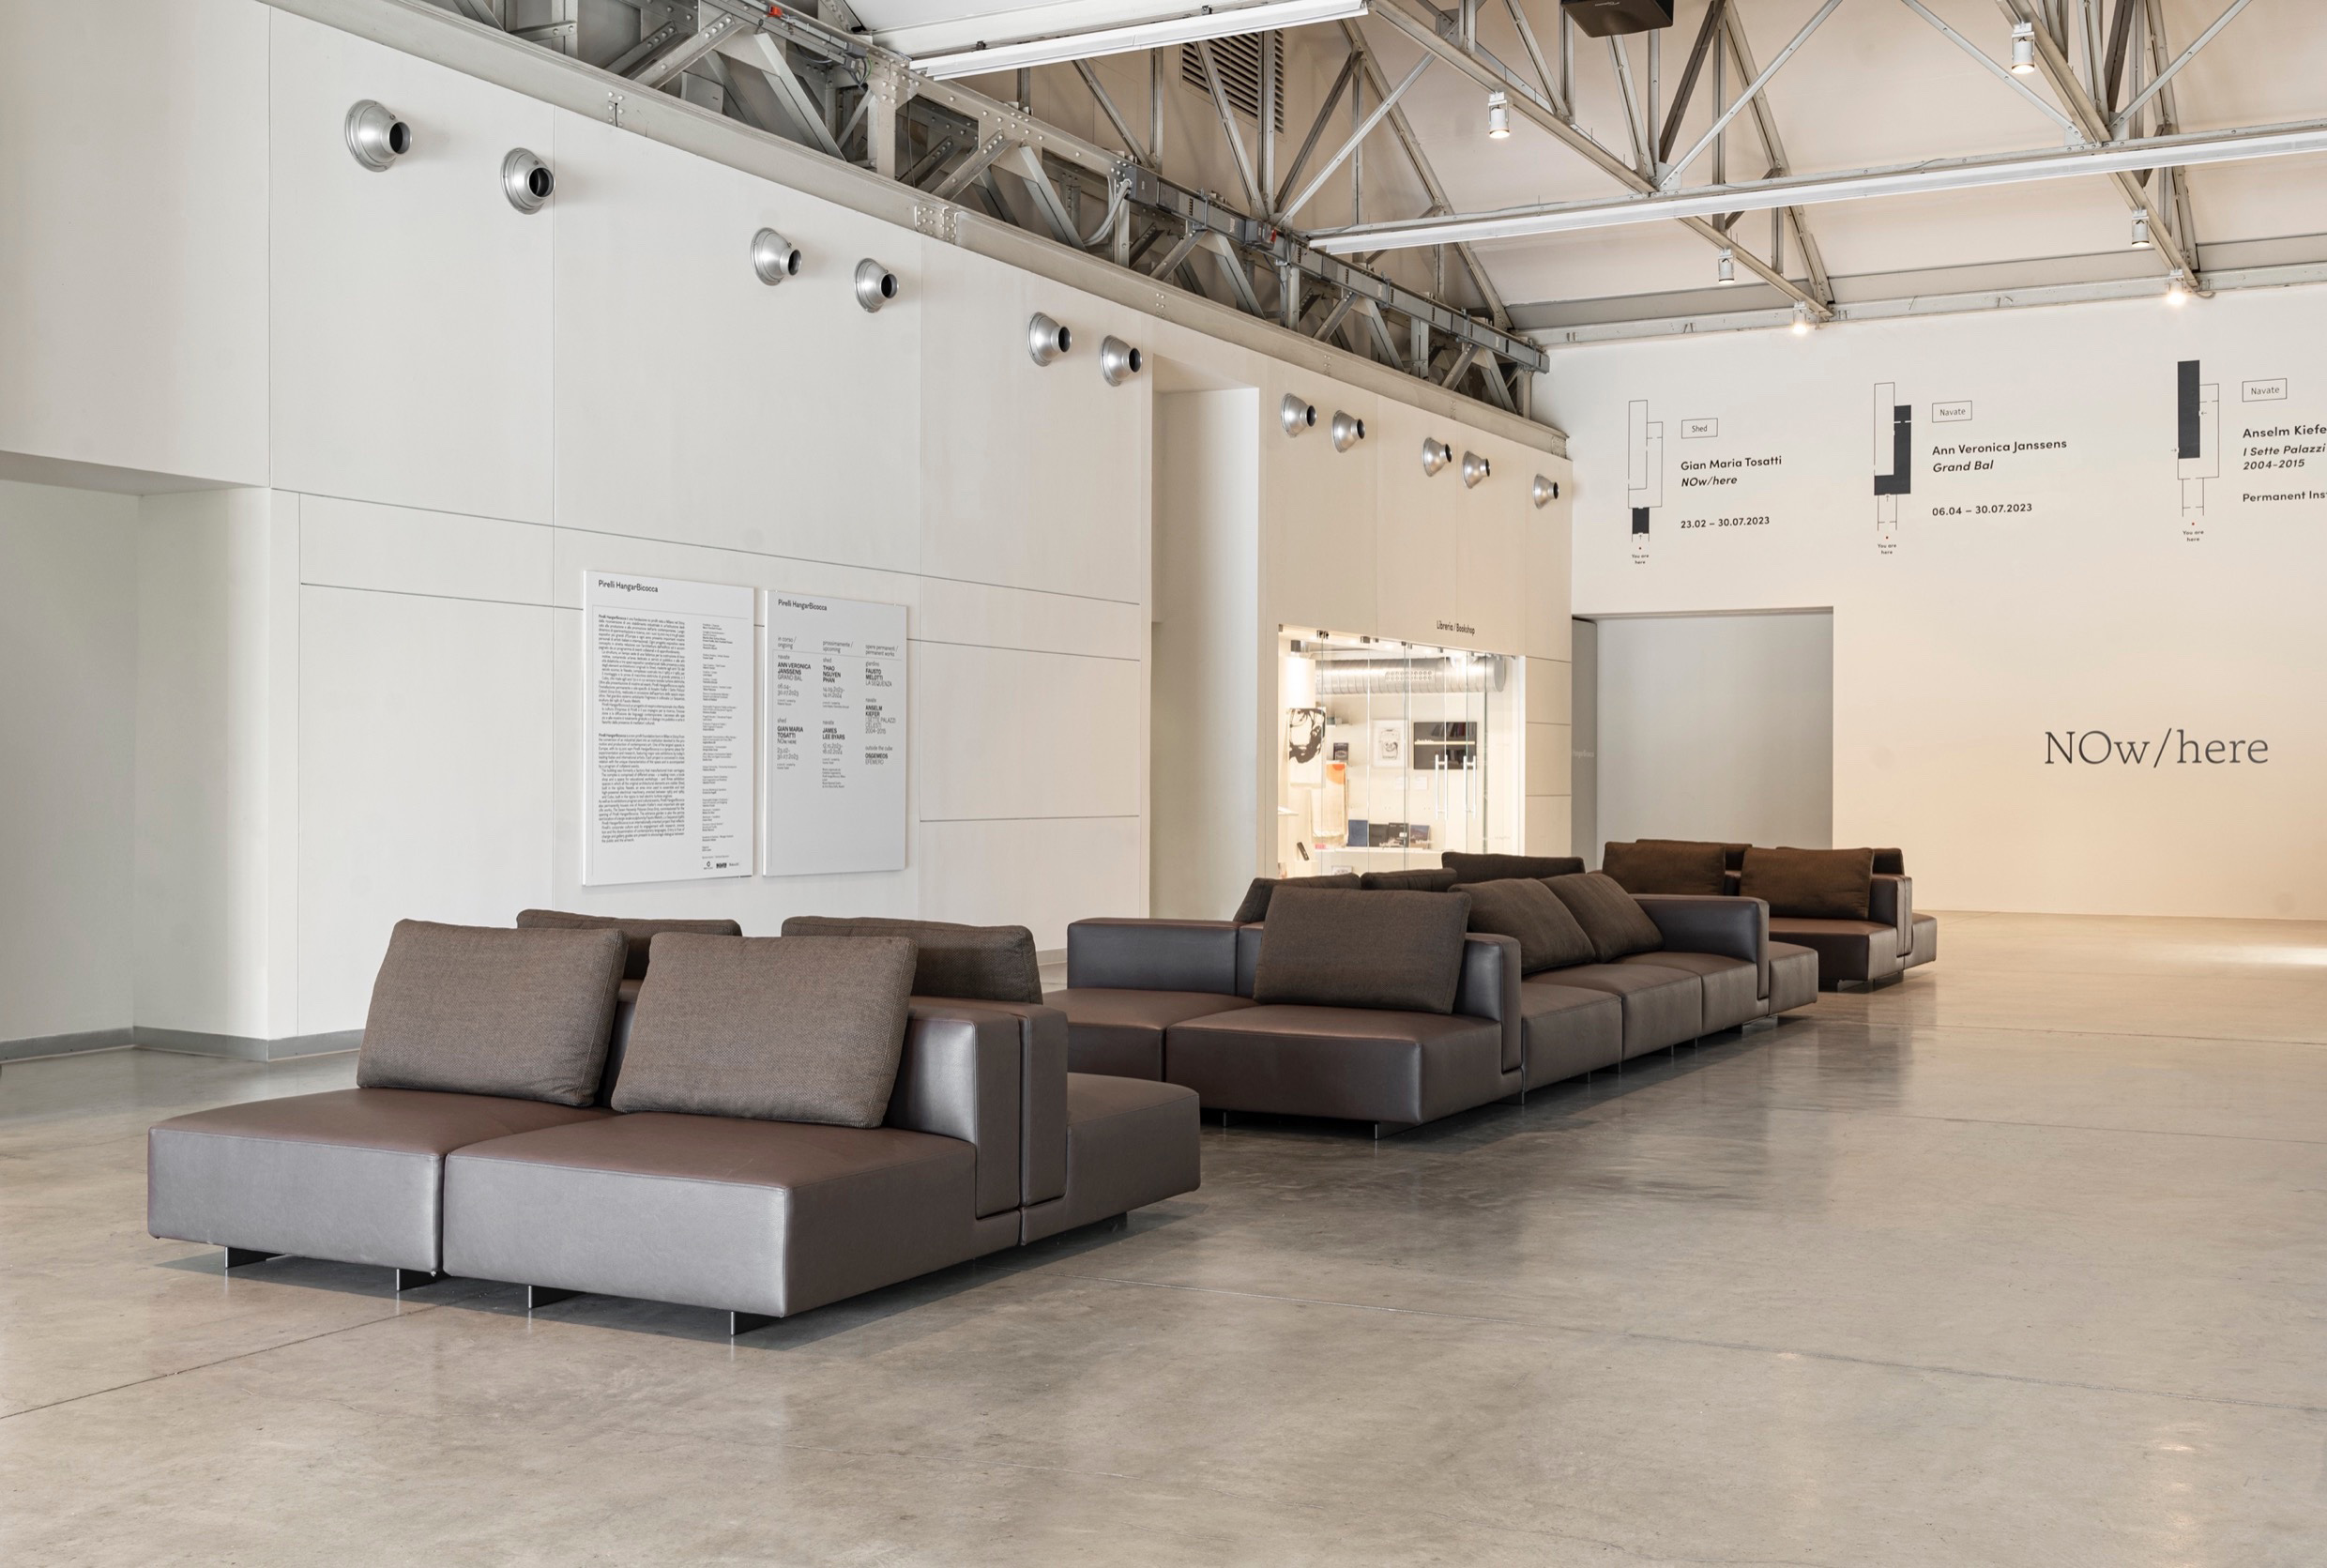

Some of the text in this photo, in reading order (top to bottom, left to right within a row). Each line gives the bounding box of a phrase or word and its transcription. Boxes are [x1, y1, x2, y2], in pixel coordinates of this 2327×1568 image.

[2251, 387, 2280, 395] Navate
[2243, 427, 2289, 438] Anselm
[1933, 440, 2067, 455] Ann Veronica Janssens
[2243, 444, 2326, 456] I Sette Palazzi
[1681, 456, 1781, 470] Gian Maria Tosatti
[1933, 460, 1993, 472] Grand Bal
[1682, 476, 1737, 487] NOw/here
[2243, 490, 2327, 502] Permanent Ins
[1933, 507, 1962, 516] 06.04
[1975, 503, 2032, 514] 30.07.2023
[1681, 520, 1706, 528] 23.02
[1719, 517, 1769, 527] 30.07.2023
[598, 580, 658, 592] Pirelli HangarBicocca
[778, 599, 827, 611] Pirelli HangarBicocca
[1436, 620, 1453, 631] Libreria
[1456, 623, 1475, 636] Bookshop
[2045, 728, 2268, 768] NOw/here
